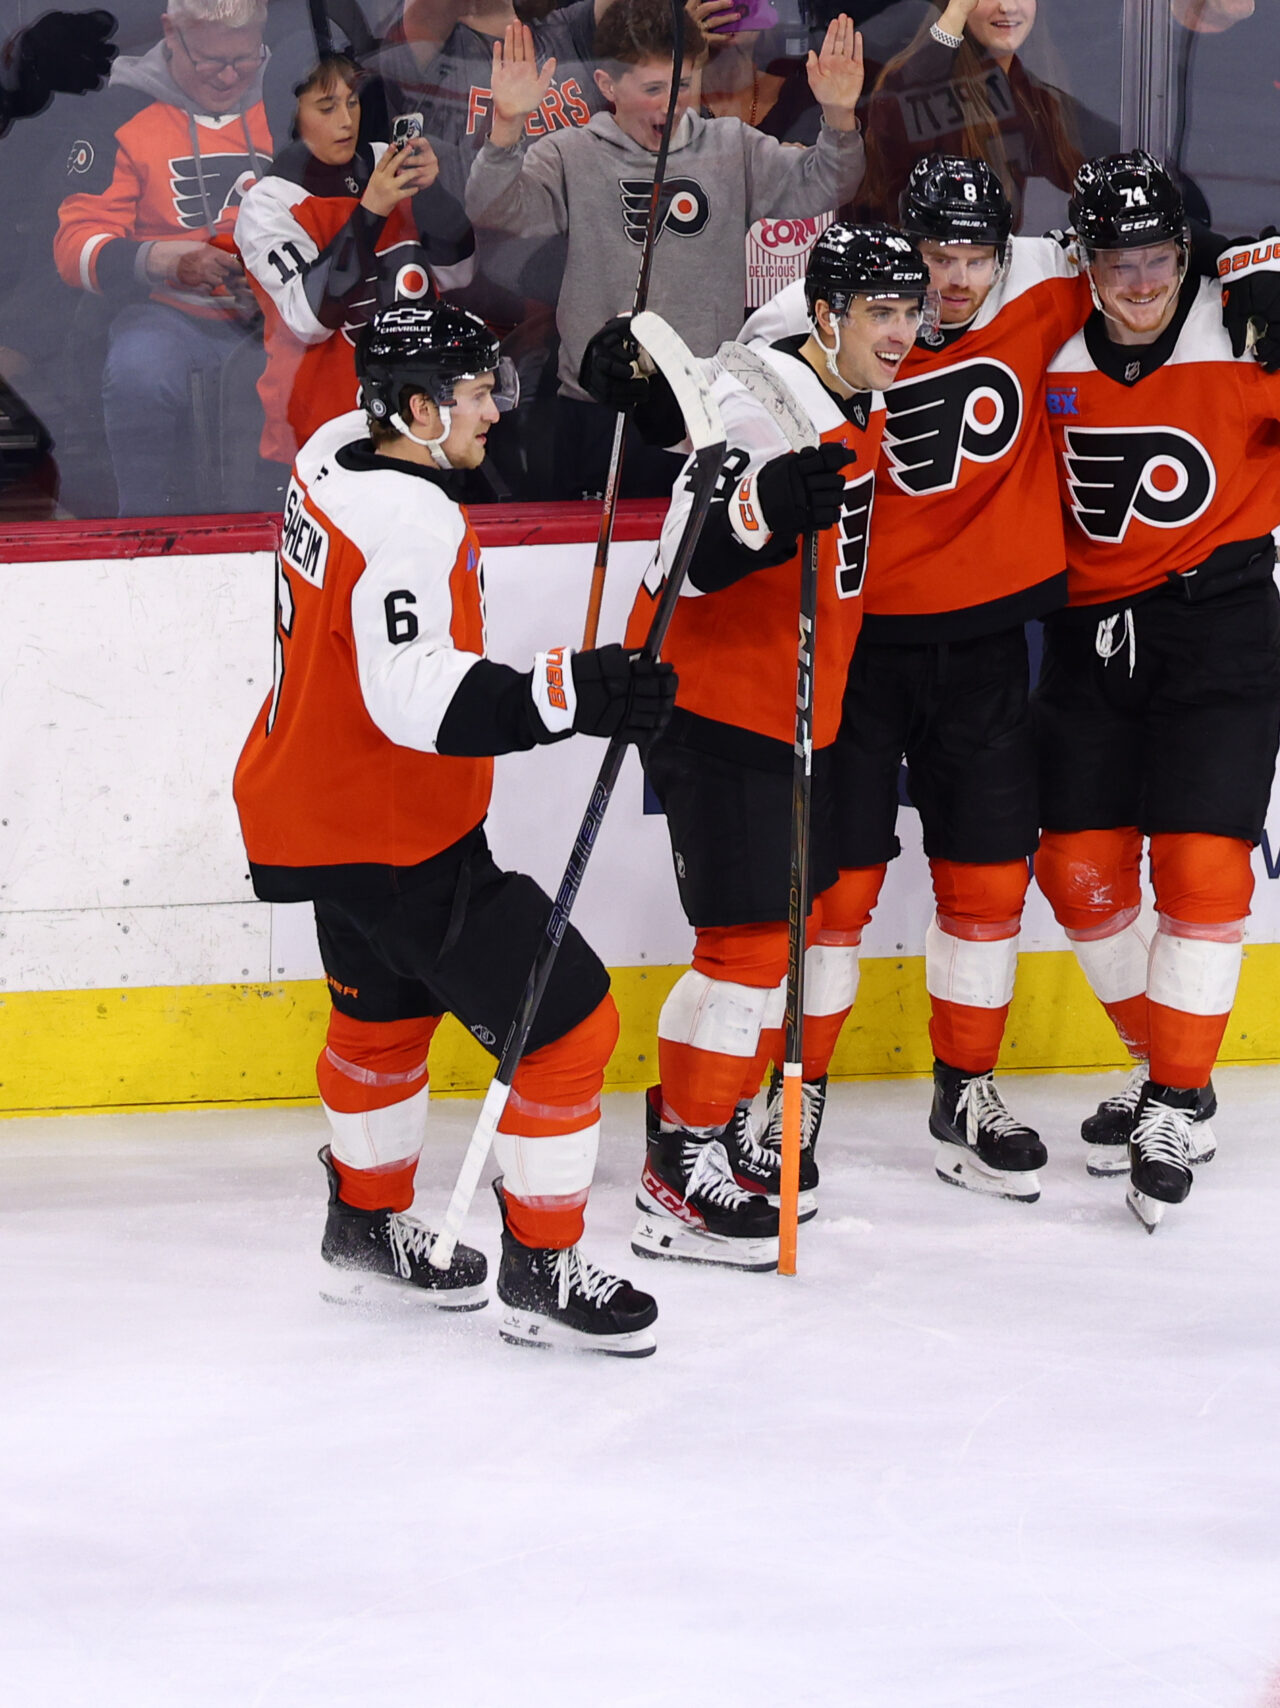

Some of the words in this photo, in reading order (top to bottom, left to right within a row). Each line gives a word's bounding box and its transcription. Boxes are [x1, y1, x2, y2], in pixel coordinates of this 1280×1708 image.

[466, 77, 590, 136] FERS
[963, 182, 978, 202] 8
[1119, 186, 1150, 208] 74
[1120, 218, 1160, 232] CCM
[267, 241, 312, 285] 11
[748, 263, 797, 279] DELICIOUS
[892, 272, 923, 281] CCM
[380, 324, 432, 335] CHEVROLET
[384, 589, 419, 645] 6
[738, 1159, 773, 1179] CCM
[642, 1168, 708, 1232] CCM
